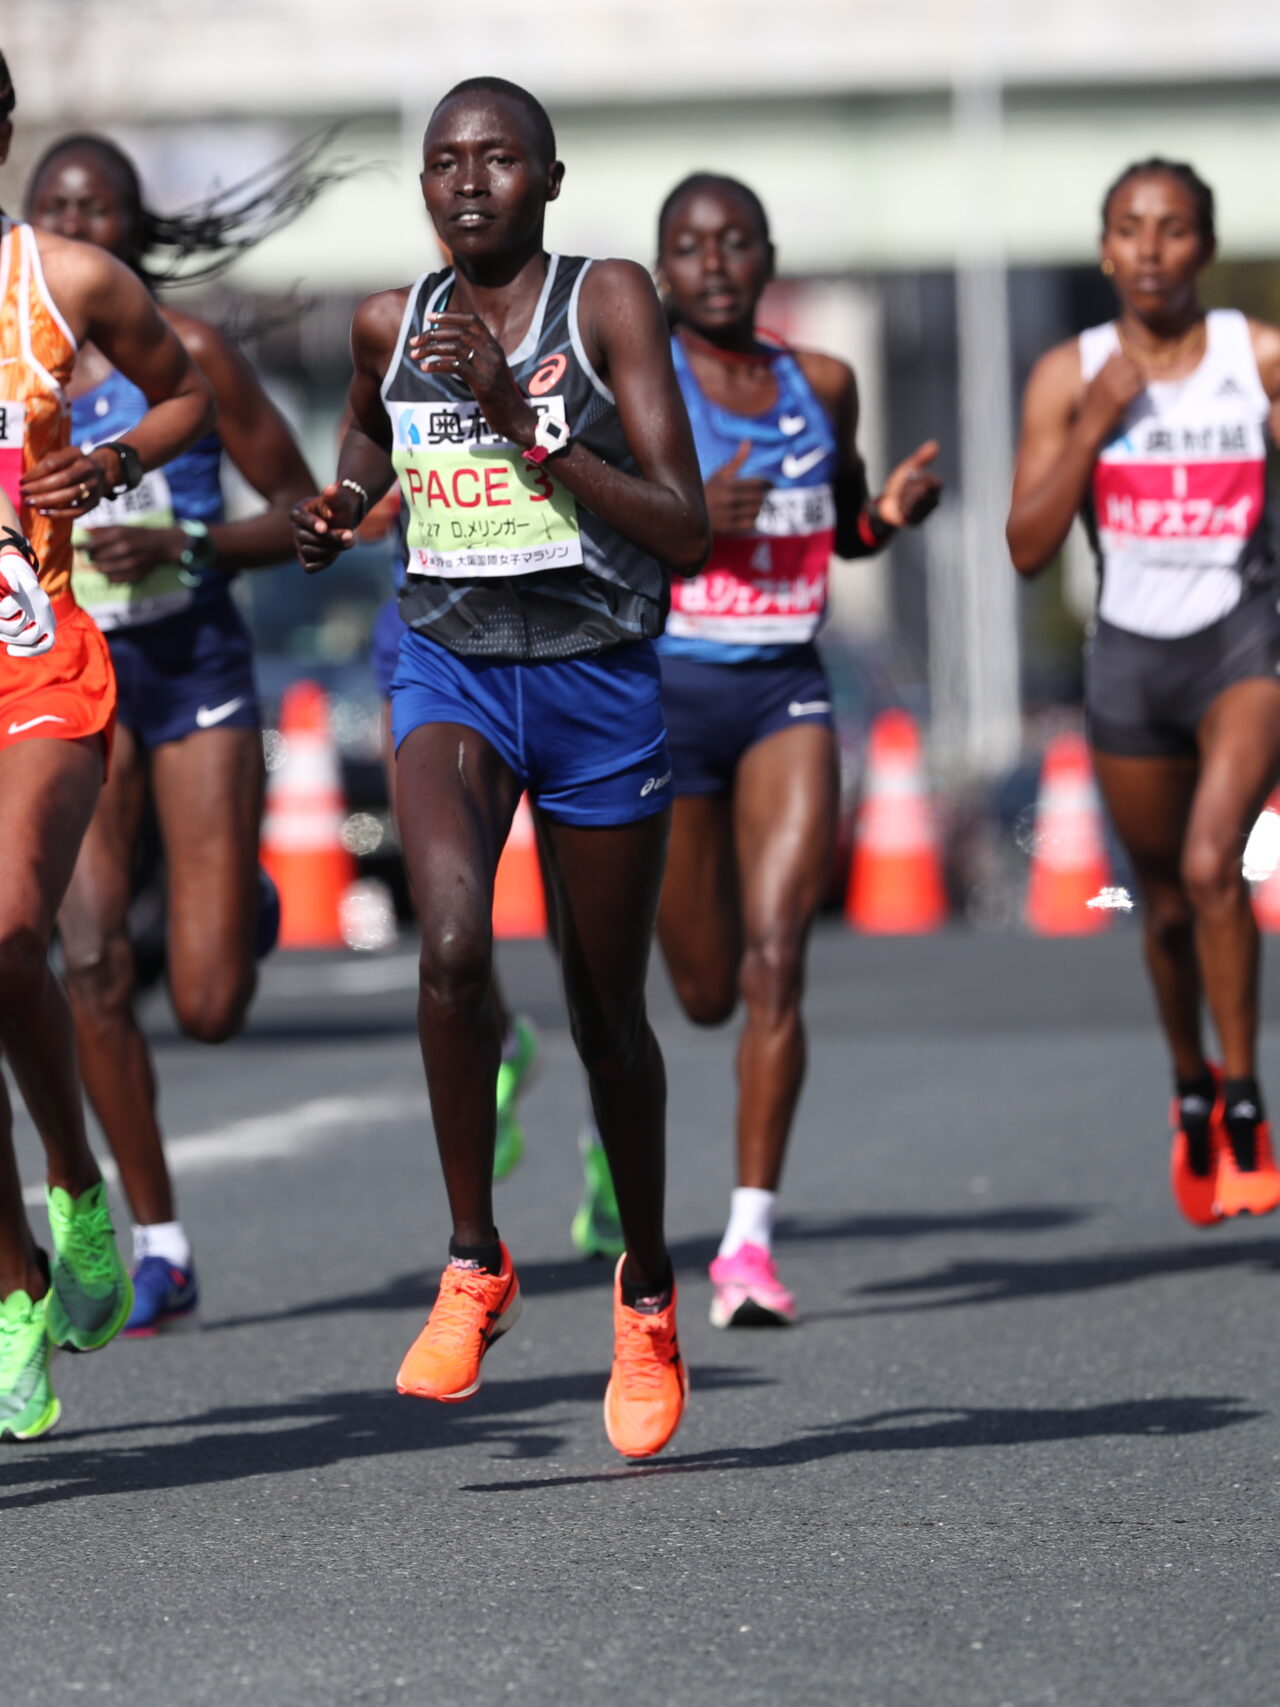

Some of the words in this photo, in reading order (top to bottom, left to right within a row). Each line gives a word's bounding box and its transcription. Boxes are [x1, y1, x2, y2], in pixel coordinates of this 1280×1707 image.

[405, 466, 512, 508] PACE
[525, 464, 555, 502] 3
[426, 522, 441, 538] 27
[450, 517, 531, 539] D.メリンガー
[456, 546, 569, 567] 大阪国際女子マラソン
